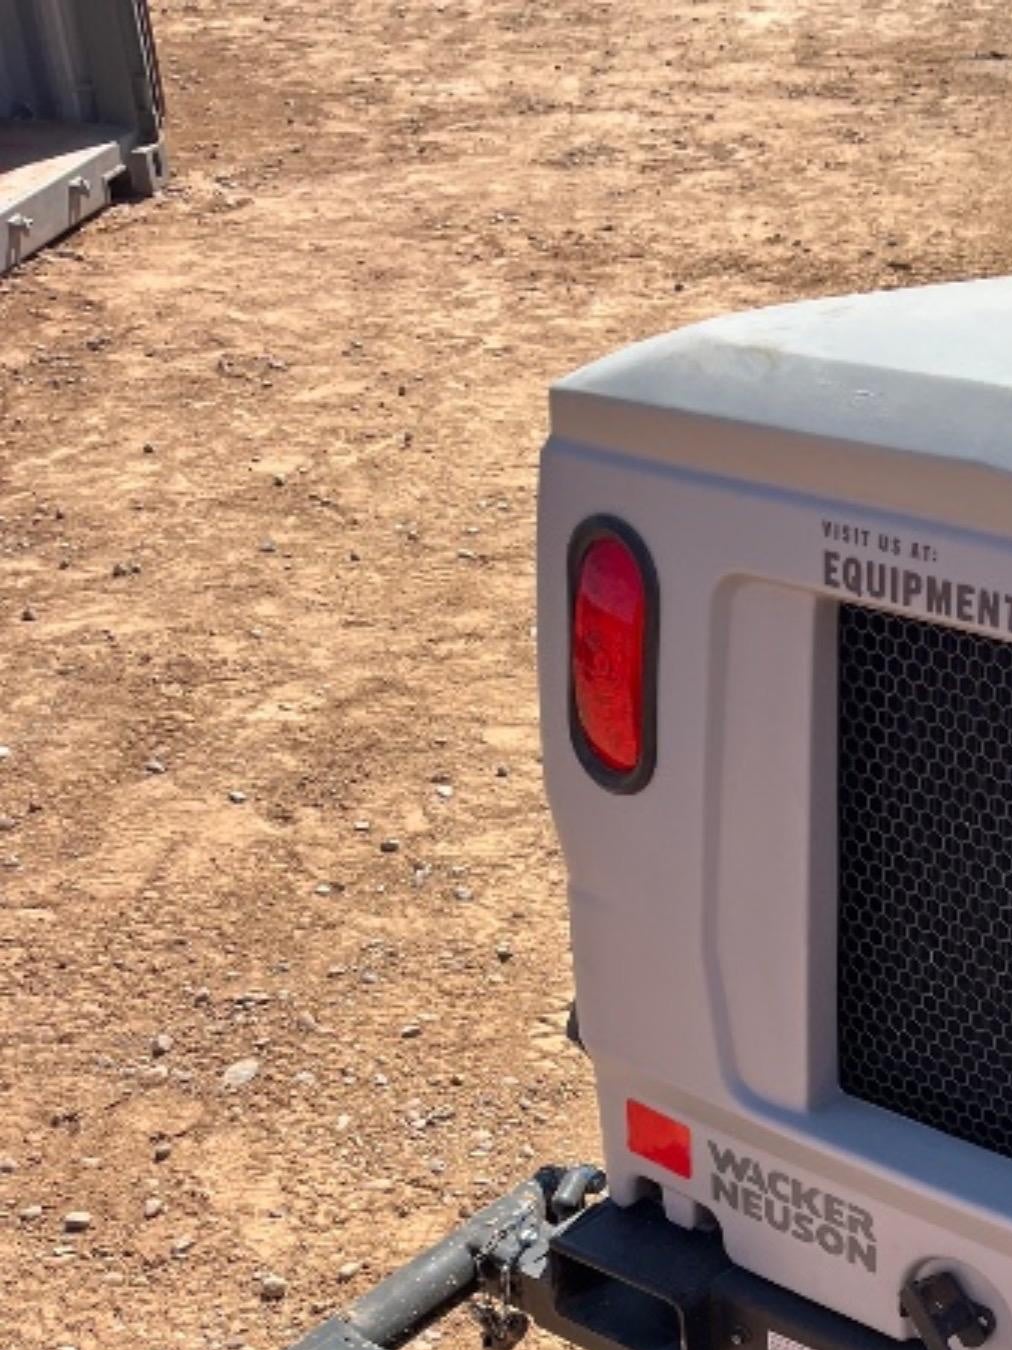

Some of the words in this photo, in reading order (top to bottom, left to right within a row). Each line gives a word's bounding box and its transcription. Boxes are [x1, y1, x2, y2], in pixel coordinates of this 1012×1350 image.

[822, 521, 869, 546] VISIT
[878, 533, 901, 554] US
[910, 542, 938, 562] AT:
[707, 1139, 877, 1243] WACKER
[710, 1175, 877, 1273] NEUSON
